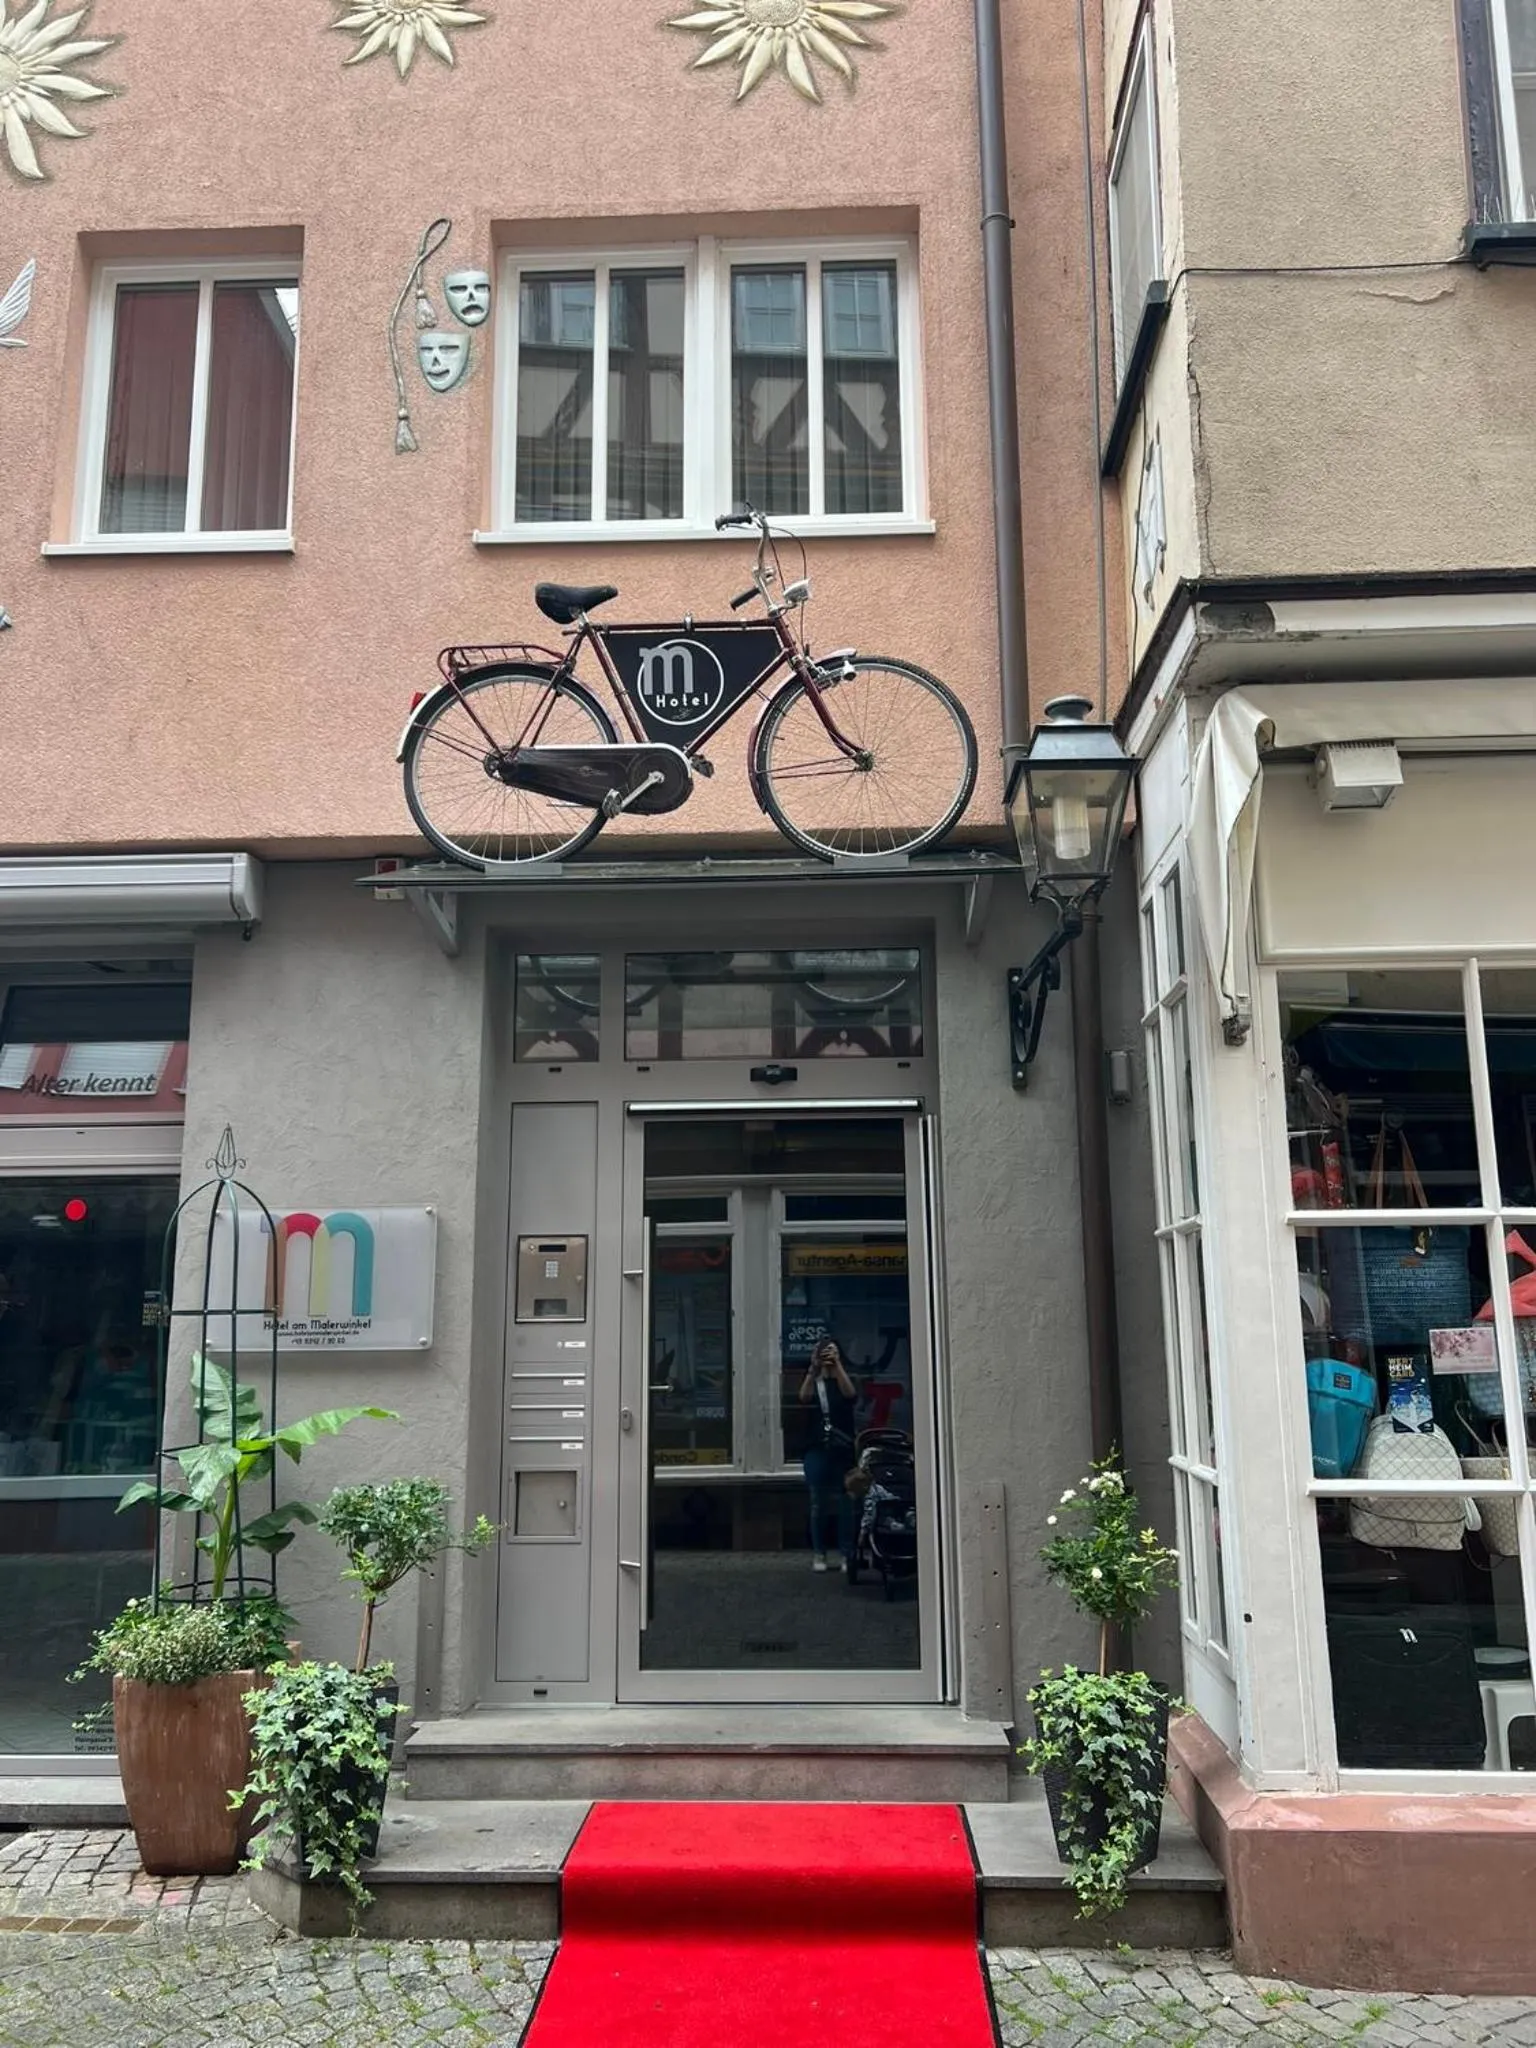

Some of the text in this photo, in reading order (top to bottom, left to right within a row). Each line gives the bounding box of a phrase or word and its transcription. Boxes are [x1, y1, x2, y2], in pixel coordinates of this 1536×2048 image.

[639, 646, 693, 695] m
[656, 692, 709, 708] Hotel
[22, 1073, 157, 1092] Alter kennt
[263, 1319, 371, 1330] Hotel am Malerwinkel
[1389, 1363, 1412, 1371] HEIM
